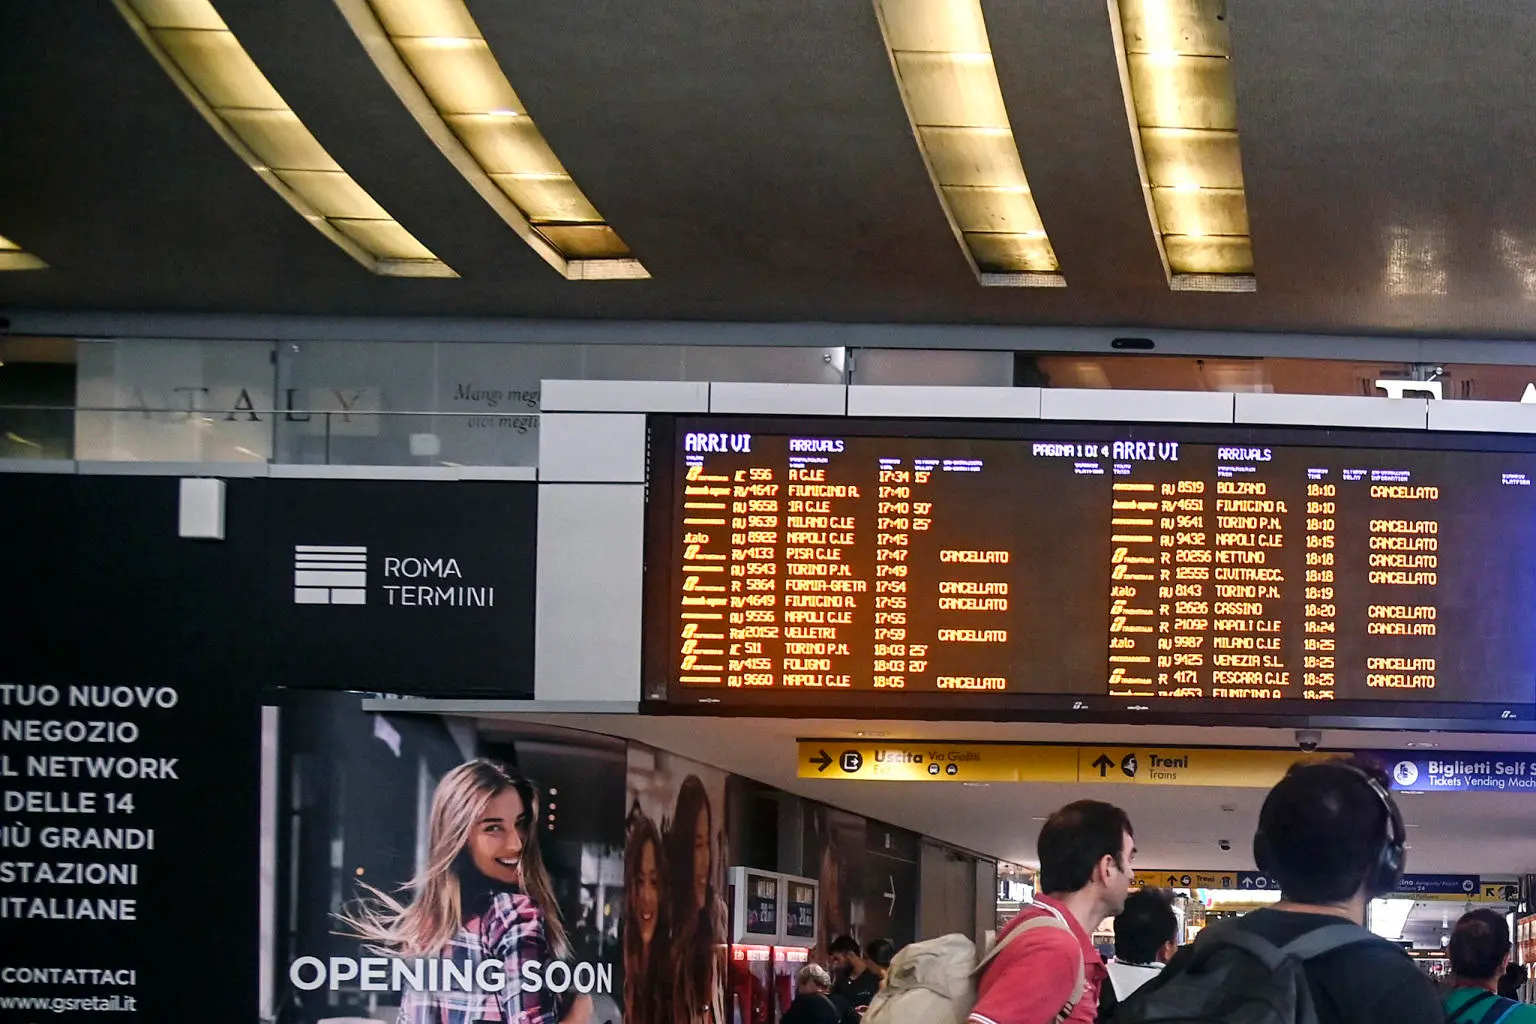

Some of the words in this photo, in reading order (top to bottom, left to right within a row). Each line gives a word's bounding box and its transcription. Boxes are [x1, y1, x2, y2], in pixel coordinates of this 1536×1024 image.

[685, 433, 750, 452] ARRIVI
[790, 439, 843, 452] ARRIVALS
[1033, 444, 1078, 456] PAGINA
[1077, 445, 1082, 457] 1
[1085, 445, 1098, 457] DI
[1101, 445, 1109, 457] 4
[1113, 441, 1178, 460] ARRIVI
[1218, 448, 1271, 460] ARRIVALS
[1178, 481, 1204, 493] 8519
[1217, 482, 1266, 494] BOLZANO
[1308, 484, 1335, 496] 18:10
[1371, 486, 1438, 499] CANCELLATO
[787, 532, 827, 544] NAPOLI
[878, 534, 908, 545] 17:45
[787, 548, 814, 559] PISA
[877, 549, 908, 561] 17:47
[940, 551, 1008, 563] CANCELLATO
[385, 558, 460, 577] ROMA
[747, 579, 776, 590] 5864
[786, 580, 866, 592] FORMIA-GAETA
[876, 581, 906, 592] 17:54
[939, 582, 1008, 594] CANCELLATO
[1175, 584, 1202, 596] 8143
[1217, 585, 1255, 597] TORINO
[1259, 586, 1280, 598] P.N.
[1305, 587, 1333, 599] 18:19
[383, 586, 494, 607] TERMINI
[1215, 602, 1262, 615] CASSINO
[1305, 604, 1335, 617] 18:20
[1369, 606, 1436, 619] CANCELLATO
[785, 627, 836, 639] VELLETRI
[875, 629, 905, 640] 17:59
[938, 630, 1007, 641] CANCELLATO
[1213, 671, 1262, 684] PESCARA
[1304, 673, 1334, 685] 18:25
[1367, 675, 1435, 688] CANCELLATO
[0, 685, 59, 705] TUO
[70, 687, 177, 707] NUOVO
[4, 721, 138, 742] NEGOZIO
[874, 750, 923, 764] Uscita
[1150, 754, 1188, 768] Treni
[0, 756, 17, 776] L
[29, 757, 177, 778] NETWORK
[1150, 769, 1177, 779] Trains
[1428, 761, 1490, 777] Biglietti
[1495, 764, 1525, 776] Self
[1429, 776, 1461, 786] Tickets
[1464, 778, 1505, 789] Vending
[6, 792, 95, 813] DELLE
[106, 793, 134, 813] 14
[0, 822, 30, 847] IÙ
[41, 828, 153, 849] GRANDI
[0, 863, 136, 884] STAZIONI
[1, 898, 136, 920] ITALIANE
[2, 968, 135, 984] CONTATTACI
[290, 957, 505, 992] OPENING
[522, 961, 612, 994] SOON
